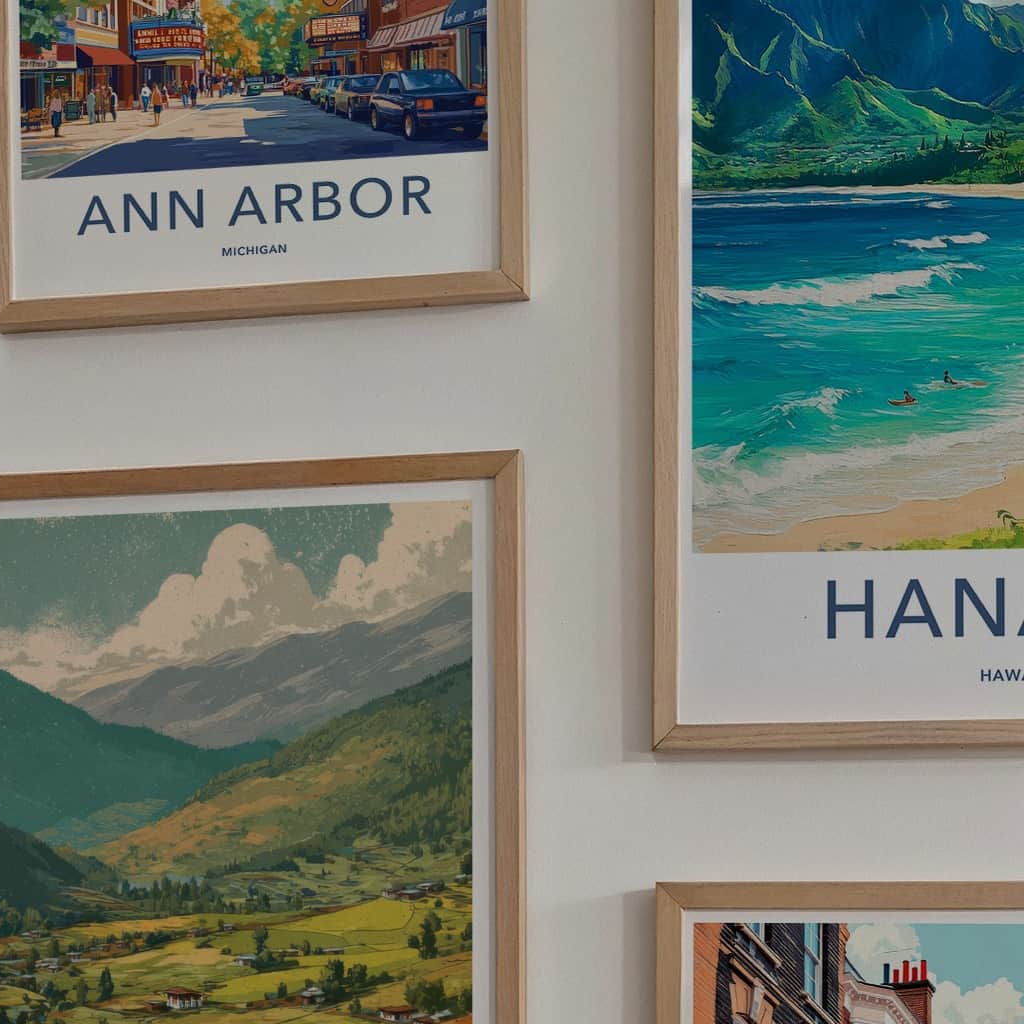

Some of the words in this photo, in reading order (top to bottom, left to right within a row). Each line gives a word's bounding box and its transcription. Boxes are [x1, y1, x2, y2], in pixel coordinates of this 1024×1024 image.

[77, 189, 205, 236] ANN
[228, 175, 432, 227] ARBOR
[221, 244, 287, 257] MICHIGAN
[826, 577, 1024, 639] HAN
[980, 668, 1024, 682] HAW
